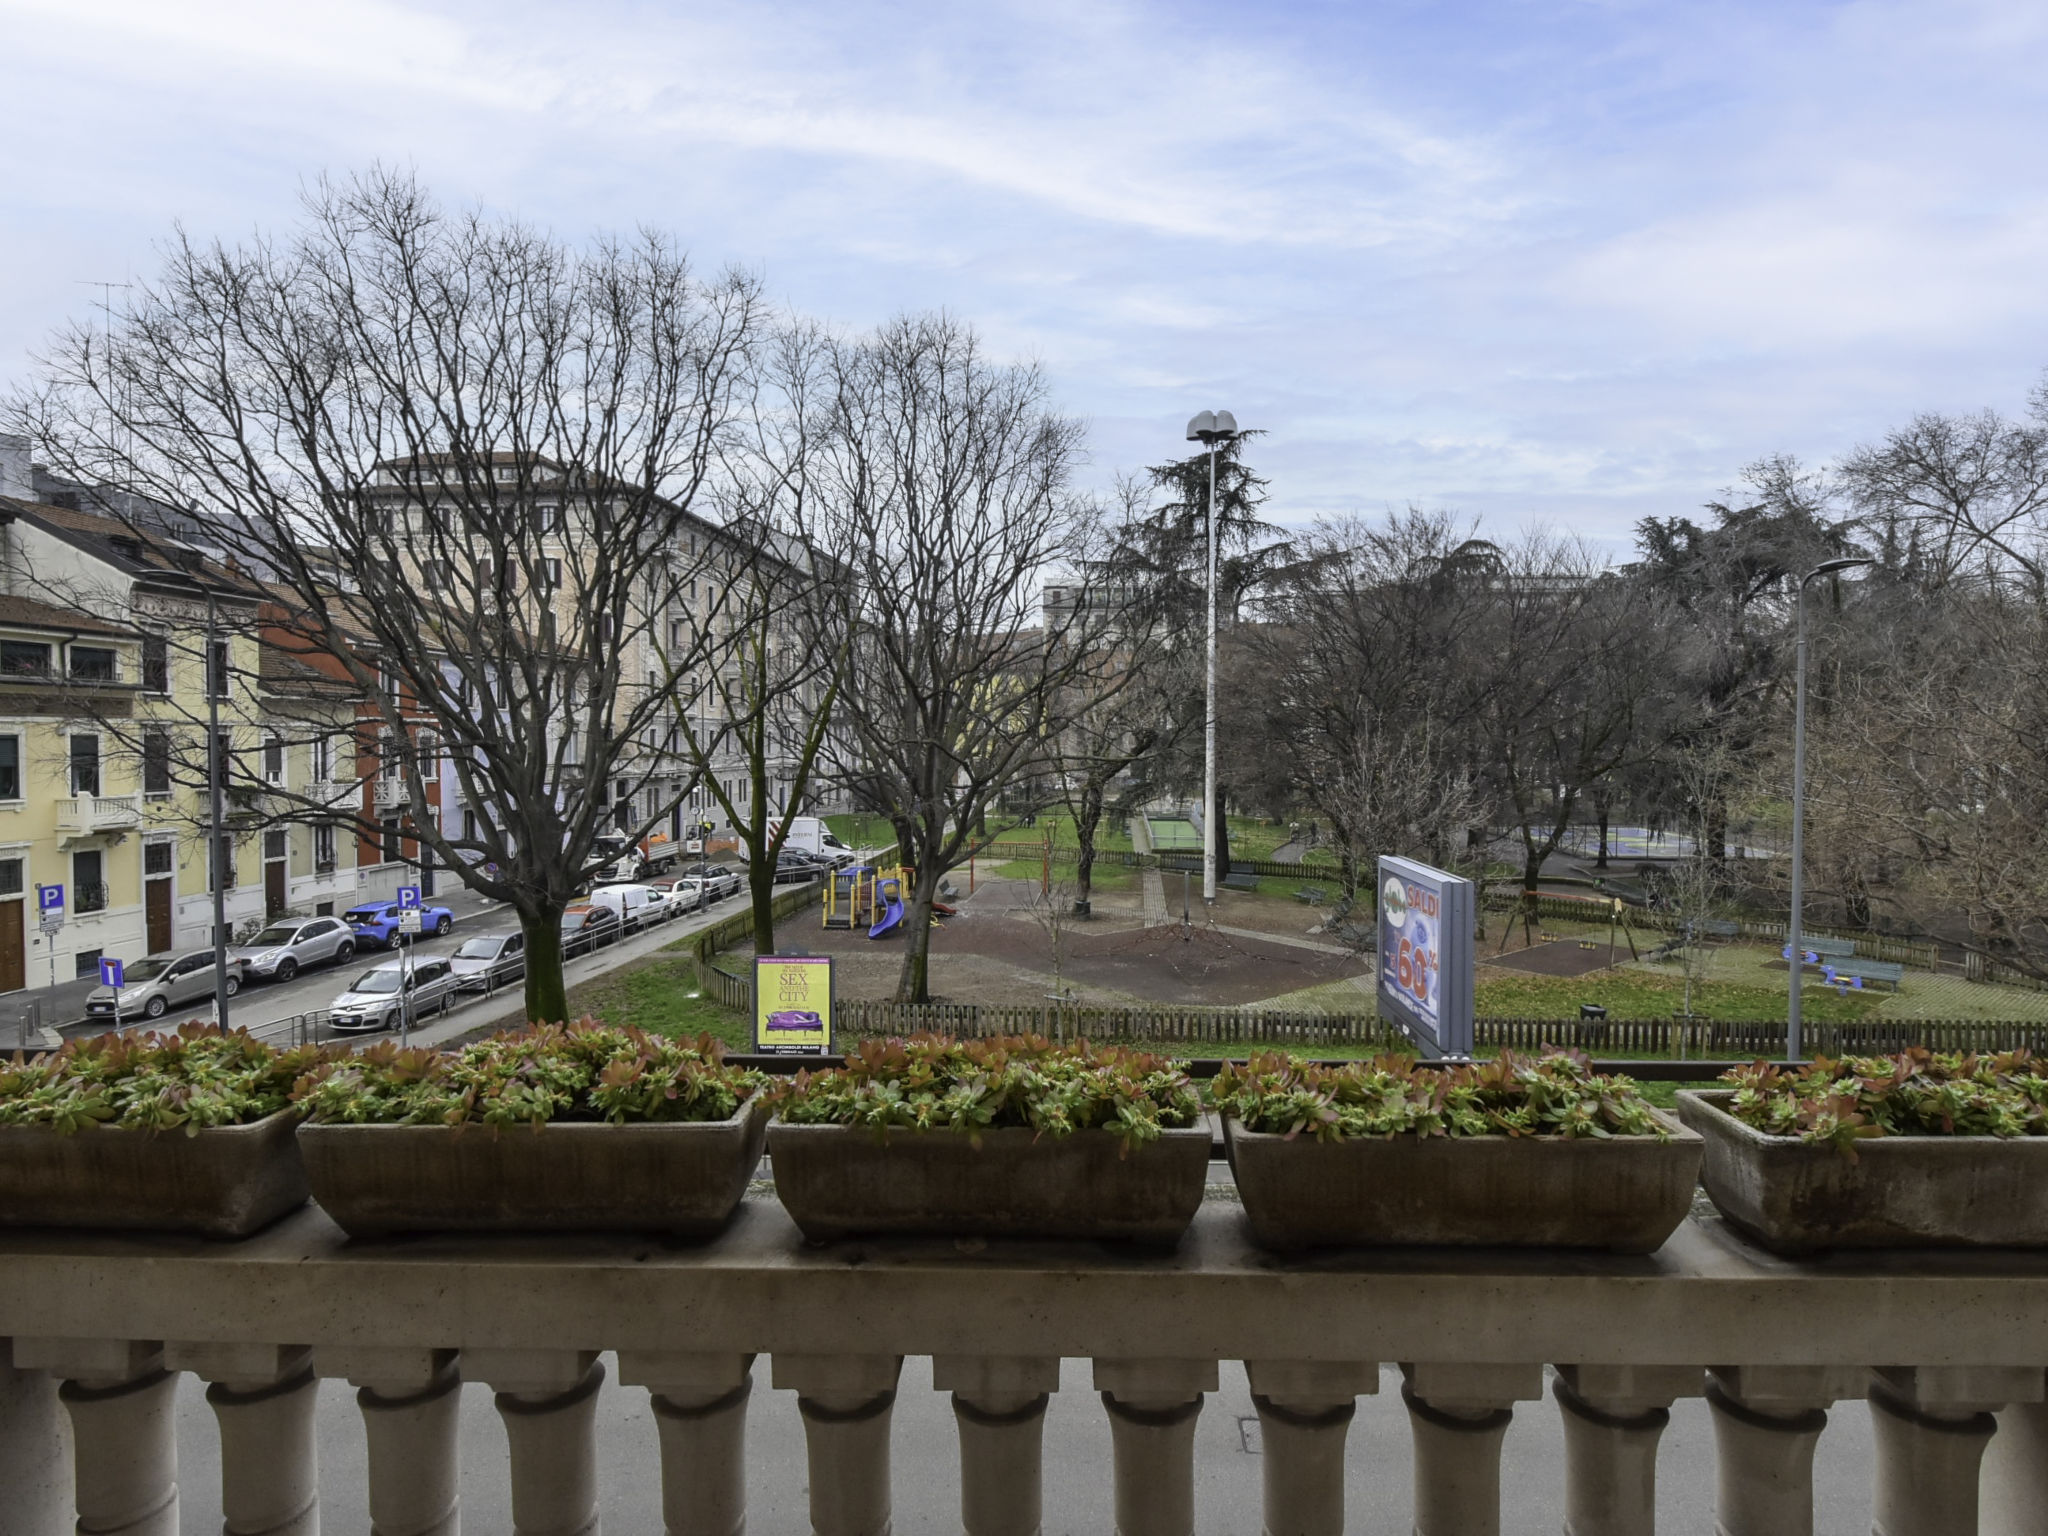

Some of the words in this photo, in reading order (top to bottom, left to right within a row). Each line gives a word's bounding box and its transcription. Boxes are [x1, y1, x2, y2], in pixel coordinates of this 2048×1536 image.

[44, 888, 59, 906] P
[401, 889, 415, 907] P
[1407, 884, 1440, 919] SALDI
[779, 973, 808, 985] SEX
[779, 991, 809, 1002] CITY
